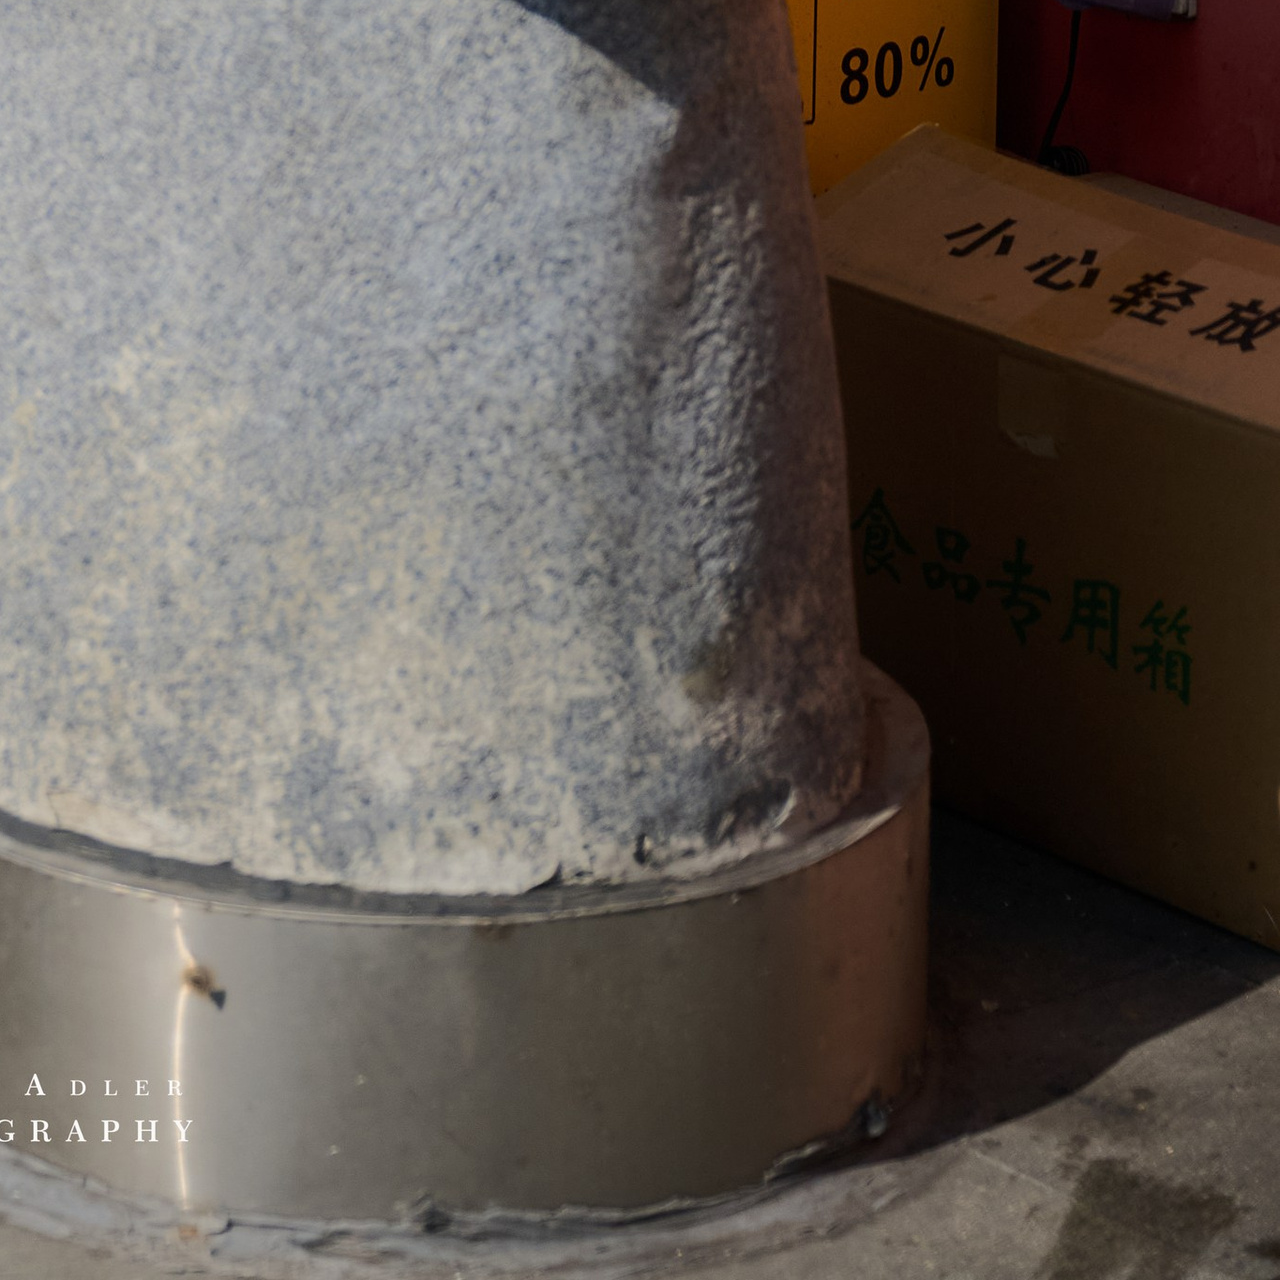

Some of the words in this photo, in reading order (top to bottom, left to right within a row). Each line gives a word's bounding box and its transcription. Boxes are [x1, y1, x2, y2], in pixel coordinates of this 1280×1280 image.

[840, 26, 955, 105] 80%
[944, 218, 1280, 353] 小心轻放
[850, 487, 1192, 707] 食品专用箱
